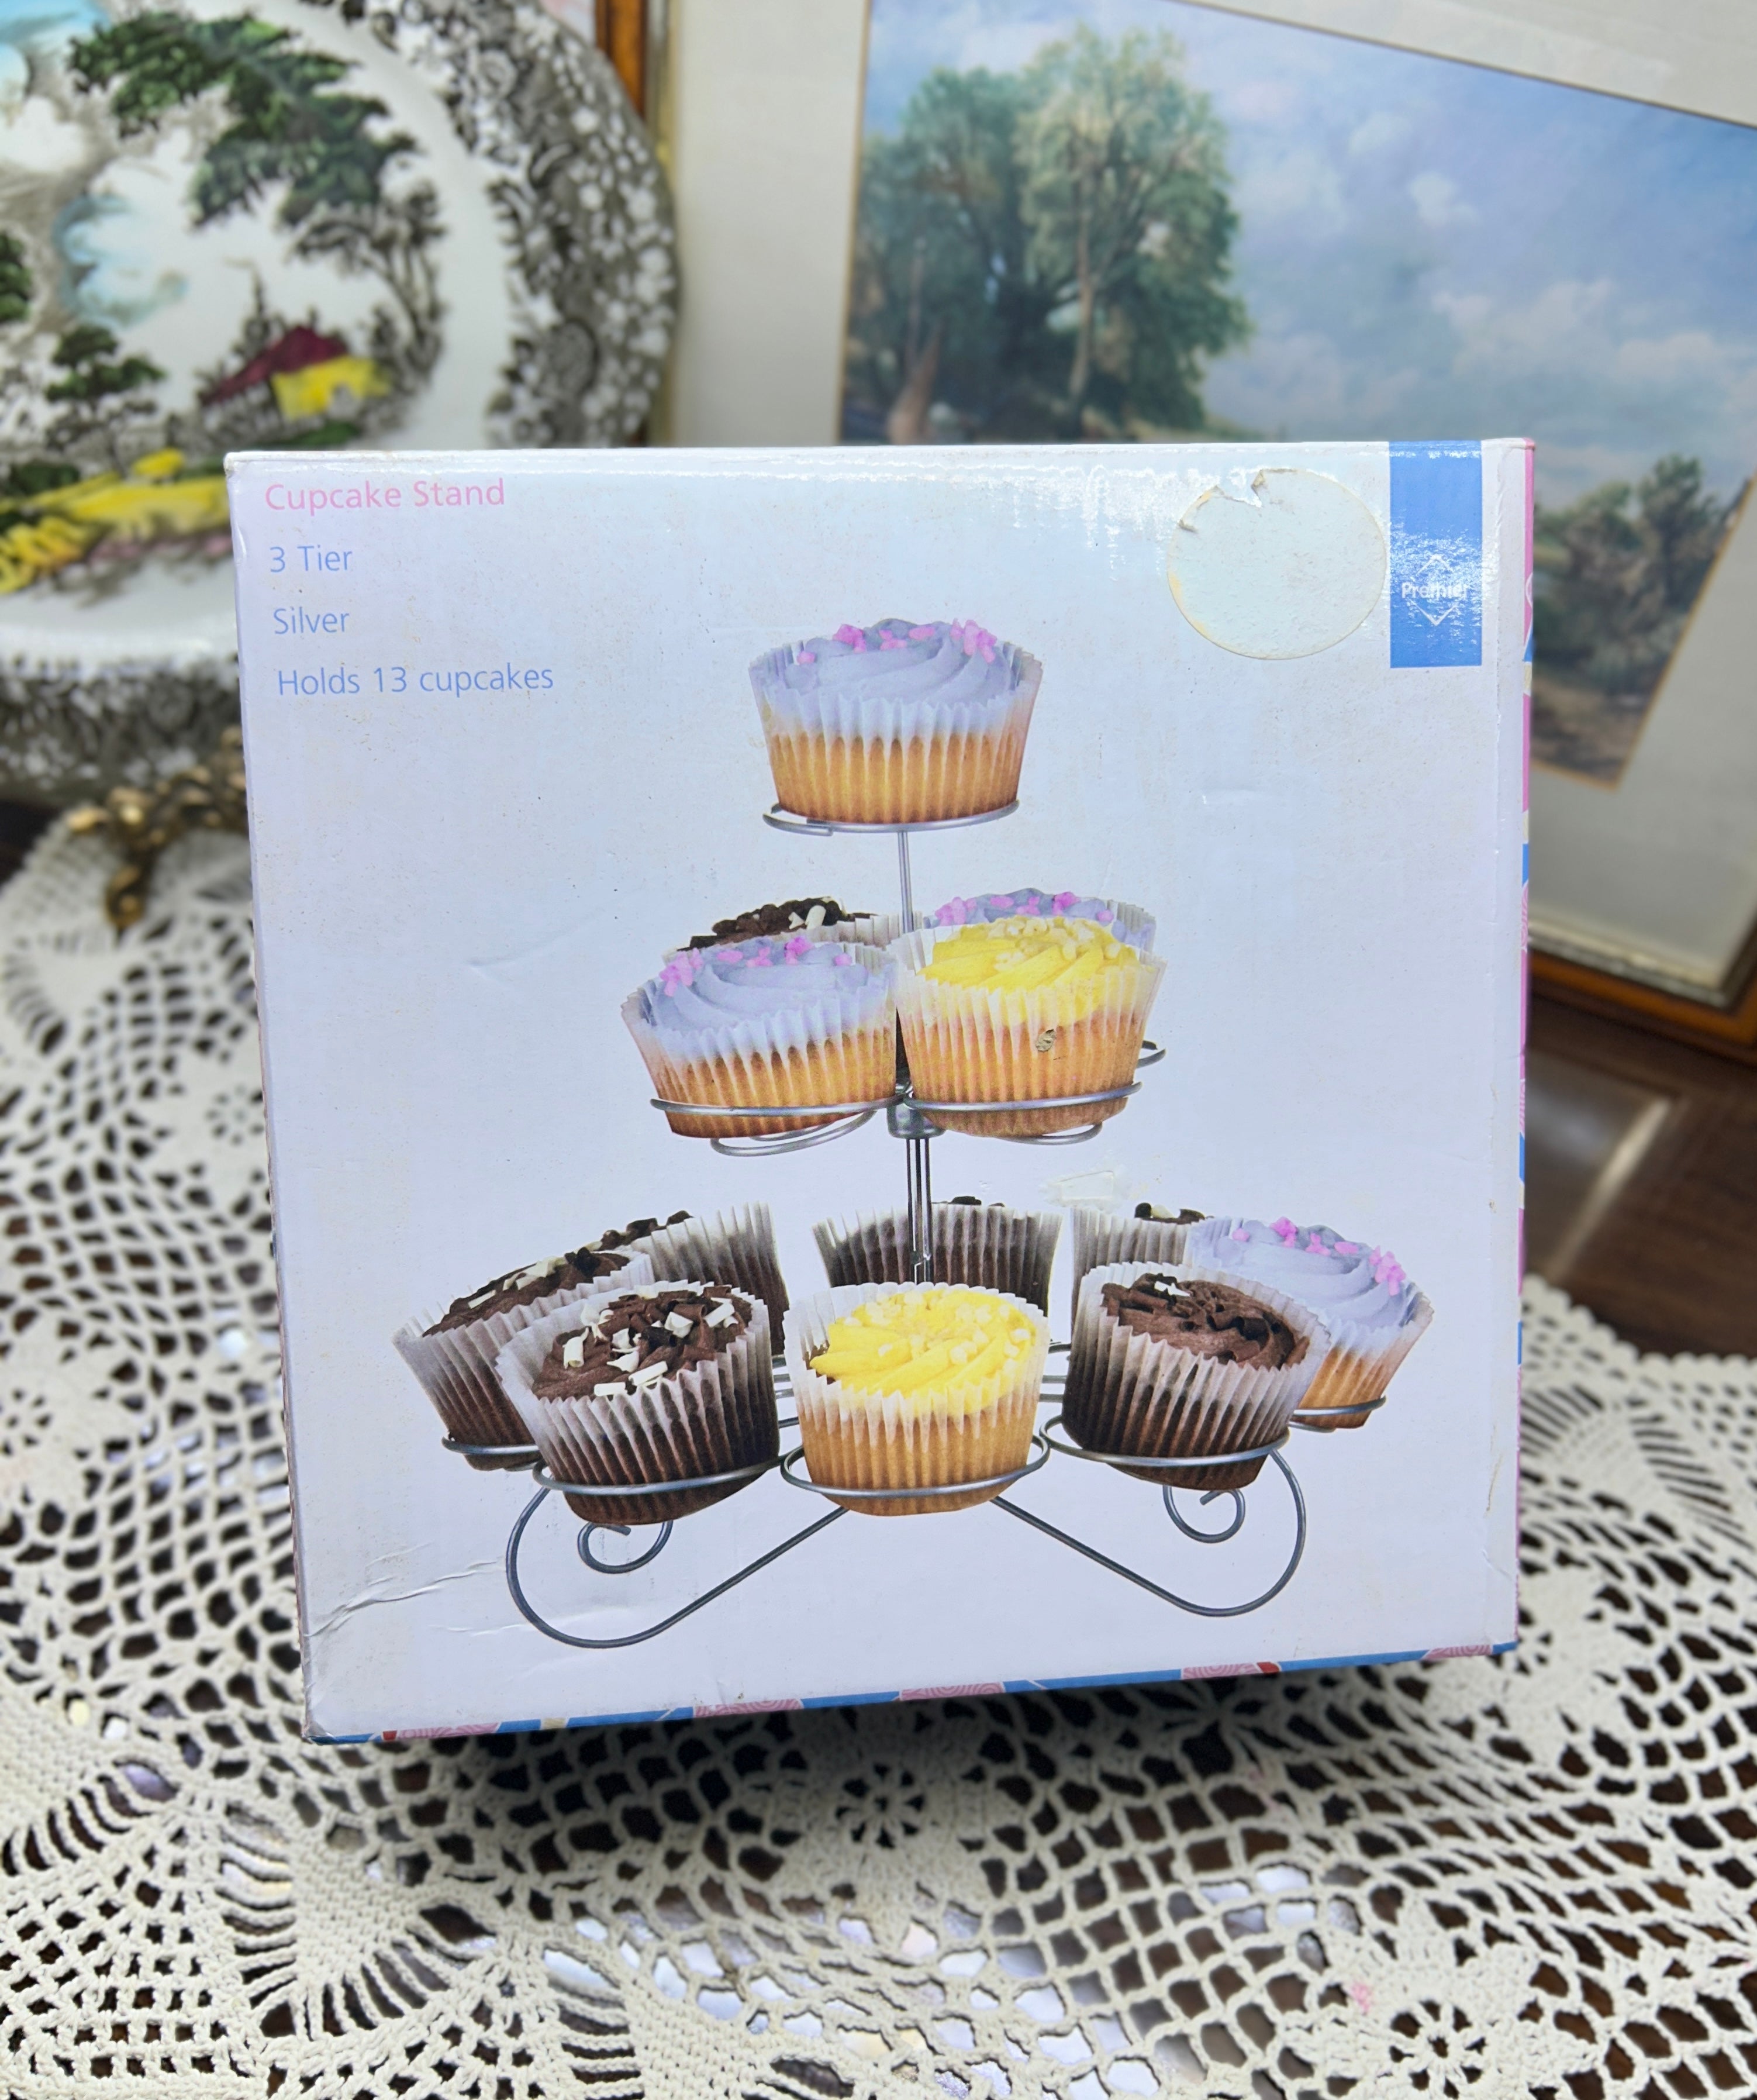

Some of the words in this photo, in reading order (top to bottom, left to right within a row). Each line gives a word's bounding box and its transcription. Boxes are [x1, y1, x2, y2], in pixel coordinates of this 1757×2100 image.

[265, 481, 401, 516] Cupcake
[413, 478, 505, 507] Stand
[270, 546, 286, 573] 3
[298, 544, 352, 572] Tier
[1402, 581, 1468, 599] Premier
[273, 607, 349, 635] Silver
[278, 667, 360, 696] Holds
[374, 667, 408, 693] 13
[419, 663, 554, 698] cupcakes
